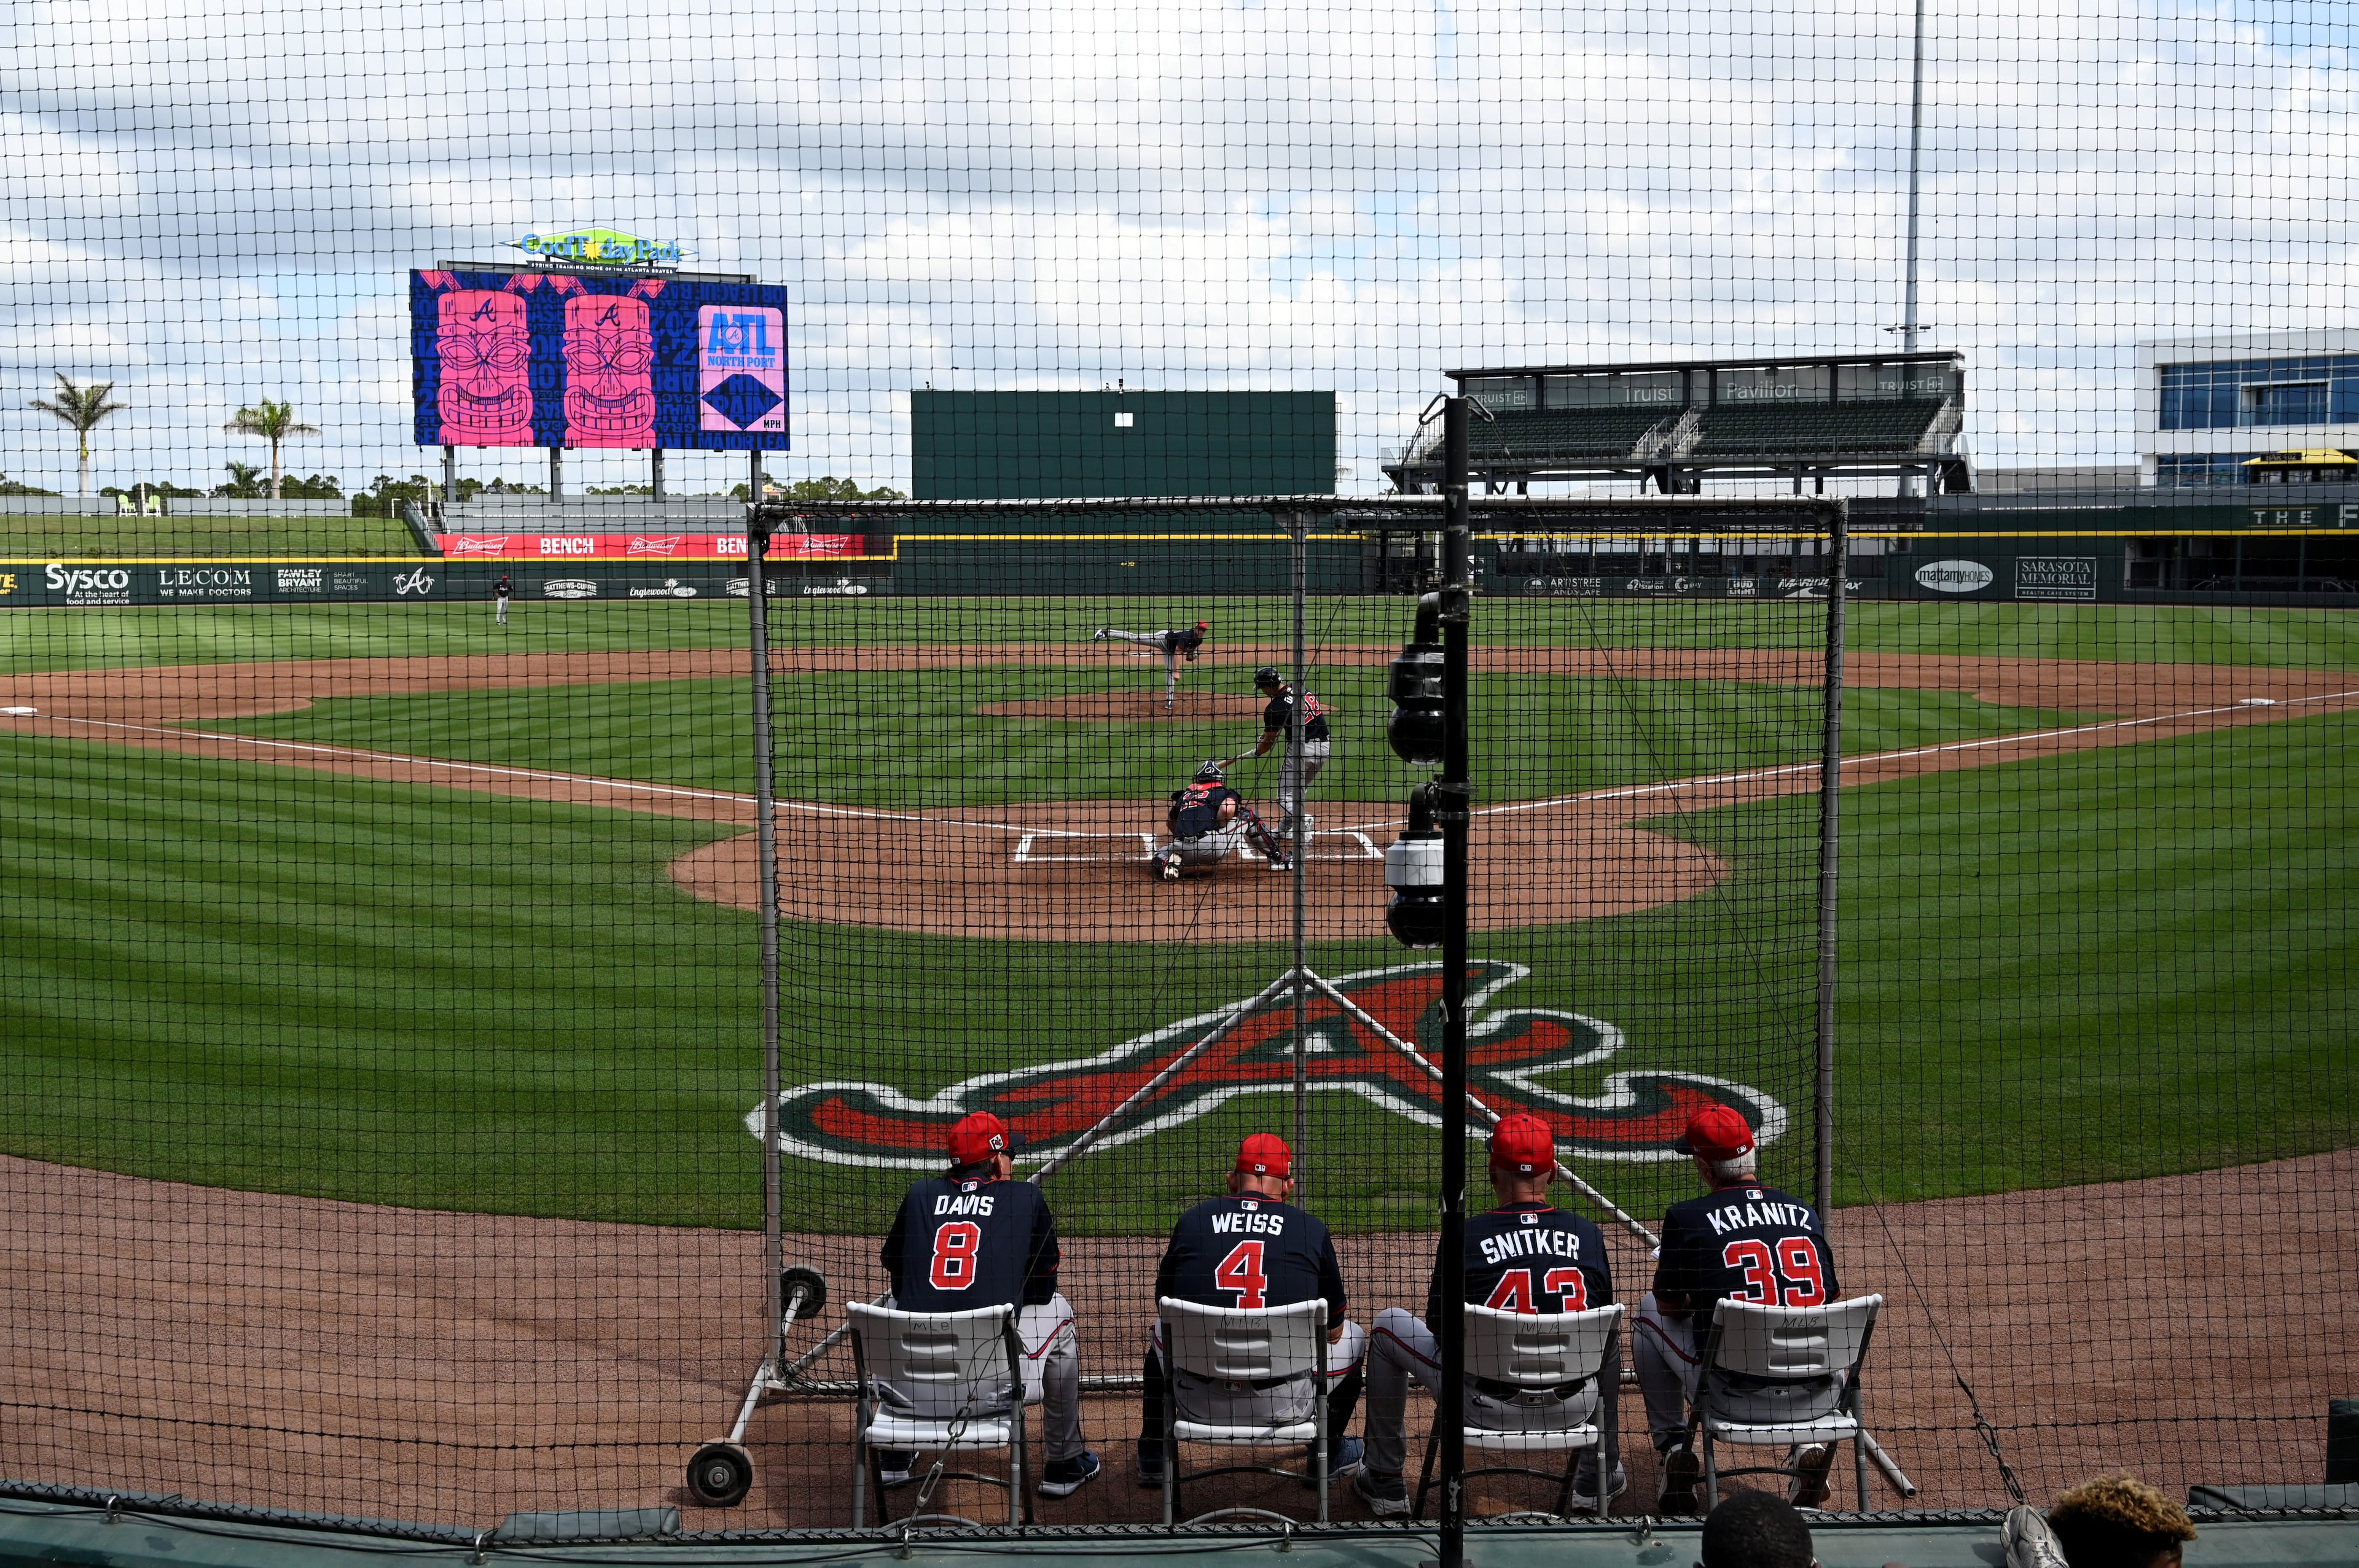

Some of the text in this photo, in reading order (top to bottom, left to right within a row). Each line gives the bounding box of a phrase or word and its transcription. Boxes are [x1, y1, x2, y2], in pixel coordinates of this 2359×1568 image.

[638, 240, 683, 261] Park
[707, 313, 775, 356] ATL
[708, 356, 775, 367] NORTH PORT
[1622, 380, 1799, 402] Truist Pavilion
[1880, 380, 1925, 391] TRUIST
[1474, 394, 1511, 403] TRUIST
[764, 419, 781, 429] MPH
[2253, 510, 2312, 525] THE
[456, 539, 504, 550] Budweiser
[540, 537, 594, 554] BENCH
[631, 540, 675, 550] Budweiser
[717, 537, 749, 553] BEN
[277, 569, 323, 578] FAWLEY
[2022, 561, 2091, 573] SARASOTA
[159, 569, 251, 585] LECOM
[278, 578, 323, 587] BRYANT
[1550, 578, 1601, 587] ARTISTREE
[2021, 573, 2091, 585] MEMORIAL
[544, 582, 597, 593] MATTHEWS-CURRIE
[1733, 580, 1753, 588] BUD
[630, 587, 671, 598] Englewood
[934, 1194, 995, 1217] DAVIS
[1211, 1212, 1285, 1236] WEISS
[1706, 1202, 1812, 1236] KRANITZ
[1479, 1228, 1579, 1265] SNITKER
[929, 1220, 982, 1290] 8
[1215, 1239, 1268, 1309] 4
[1722, 1236, 1826, 1307] 39
[1484, 1266, 1588, 1314] 43
[1782, 1316, 1820, 1327] MLB
